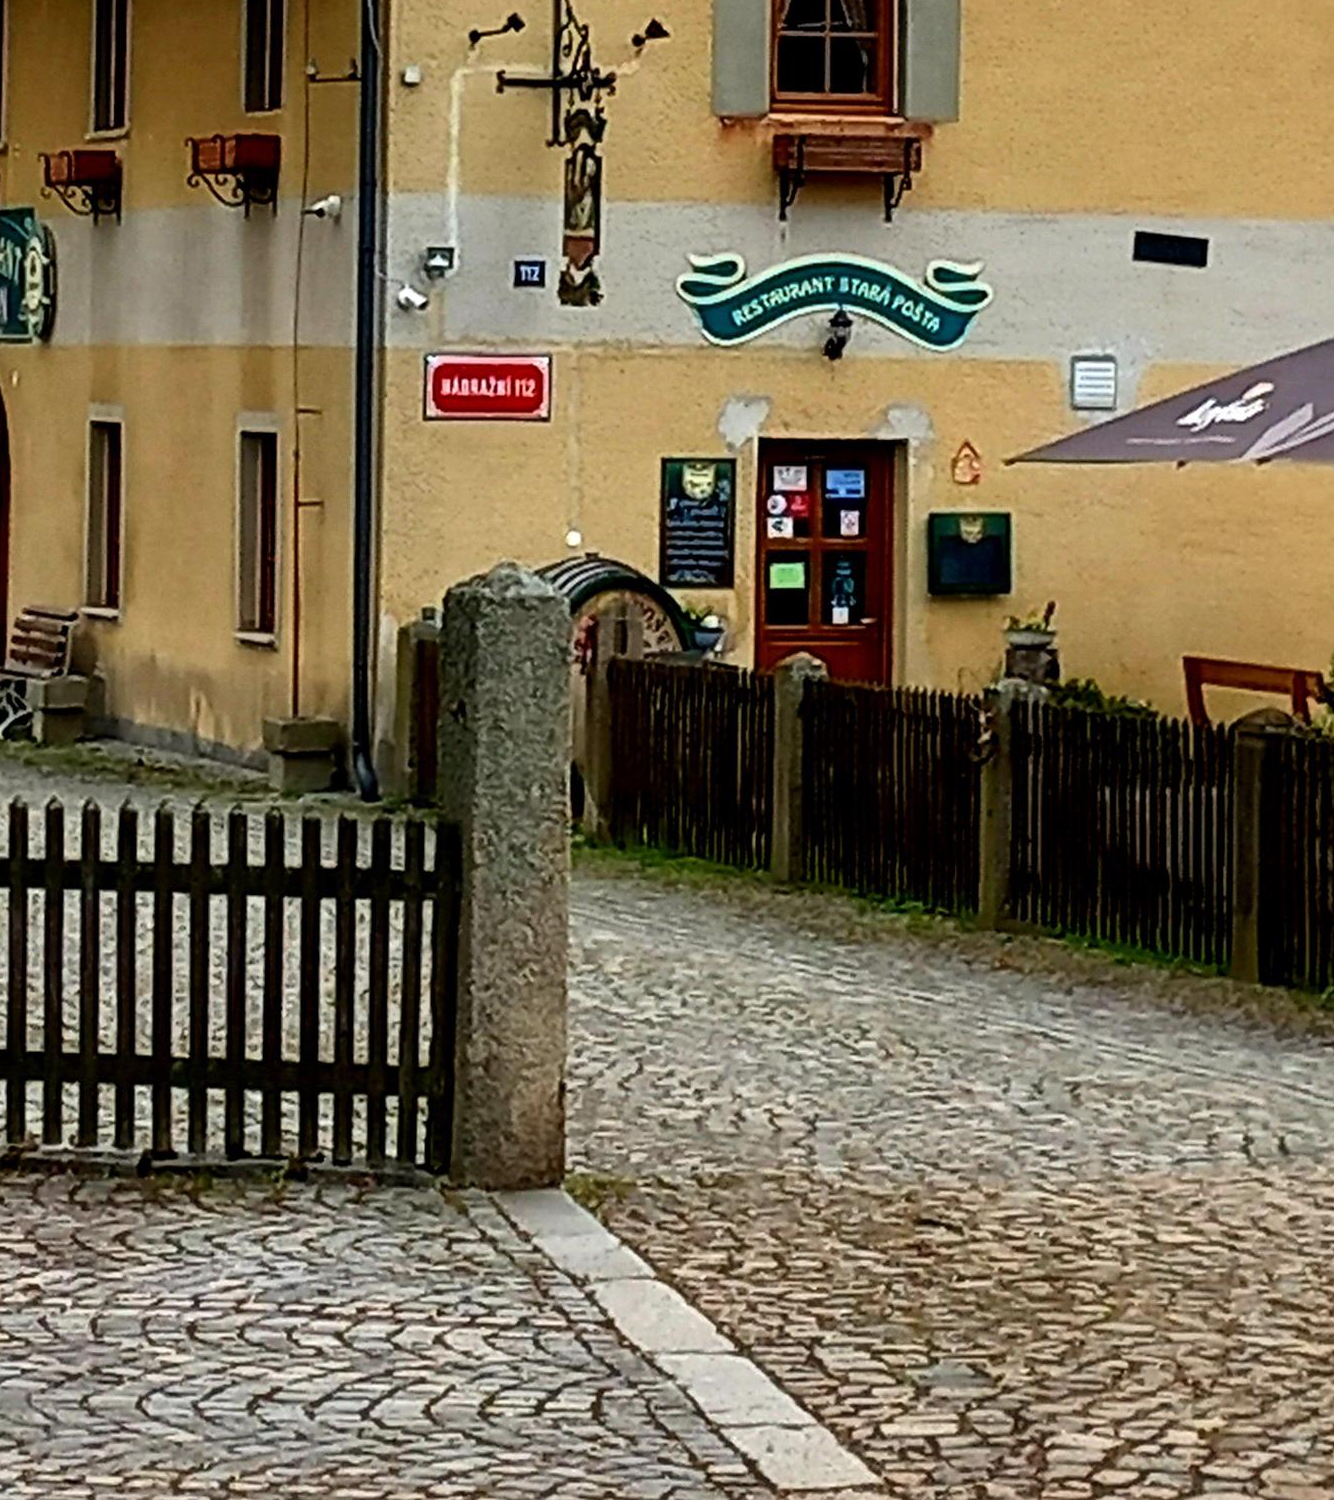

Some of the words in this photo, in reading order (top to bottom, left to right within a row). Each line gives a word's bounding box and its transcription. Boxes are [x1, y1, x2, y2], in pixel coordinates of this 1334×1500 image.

[520, 265, 540, 281] 112
[732, 276, 834, 327] RESTAURANT
[892, 294, 941, 332] POŠTA
[440, 374, 511, 398] NÁDRAŽNÍ
[515, 378, 536, 398] 112
